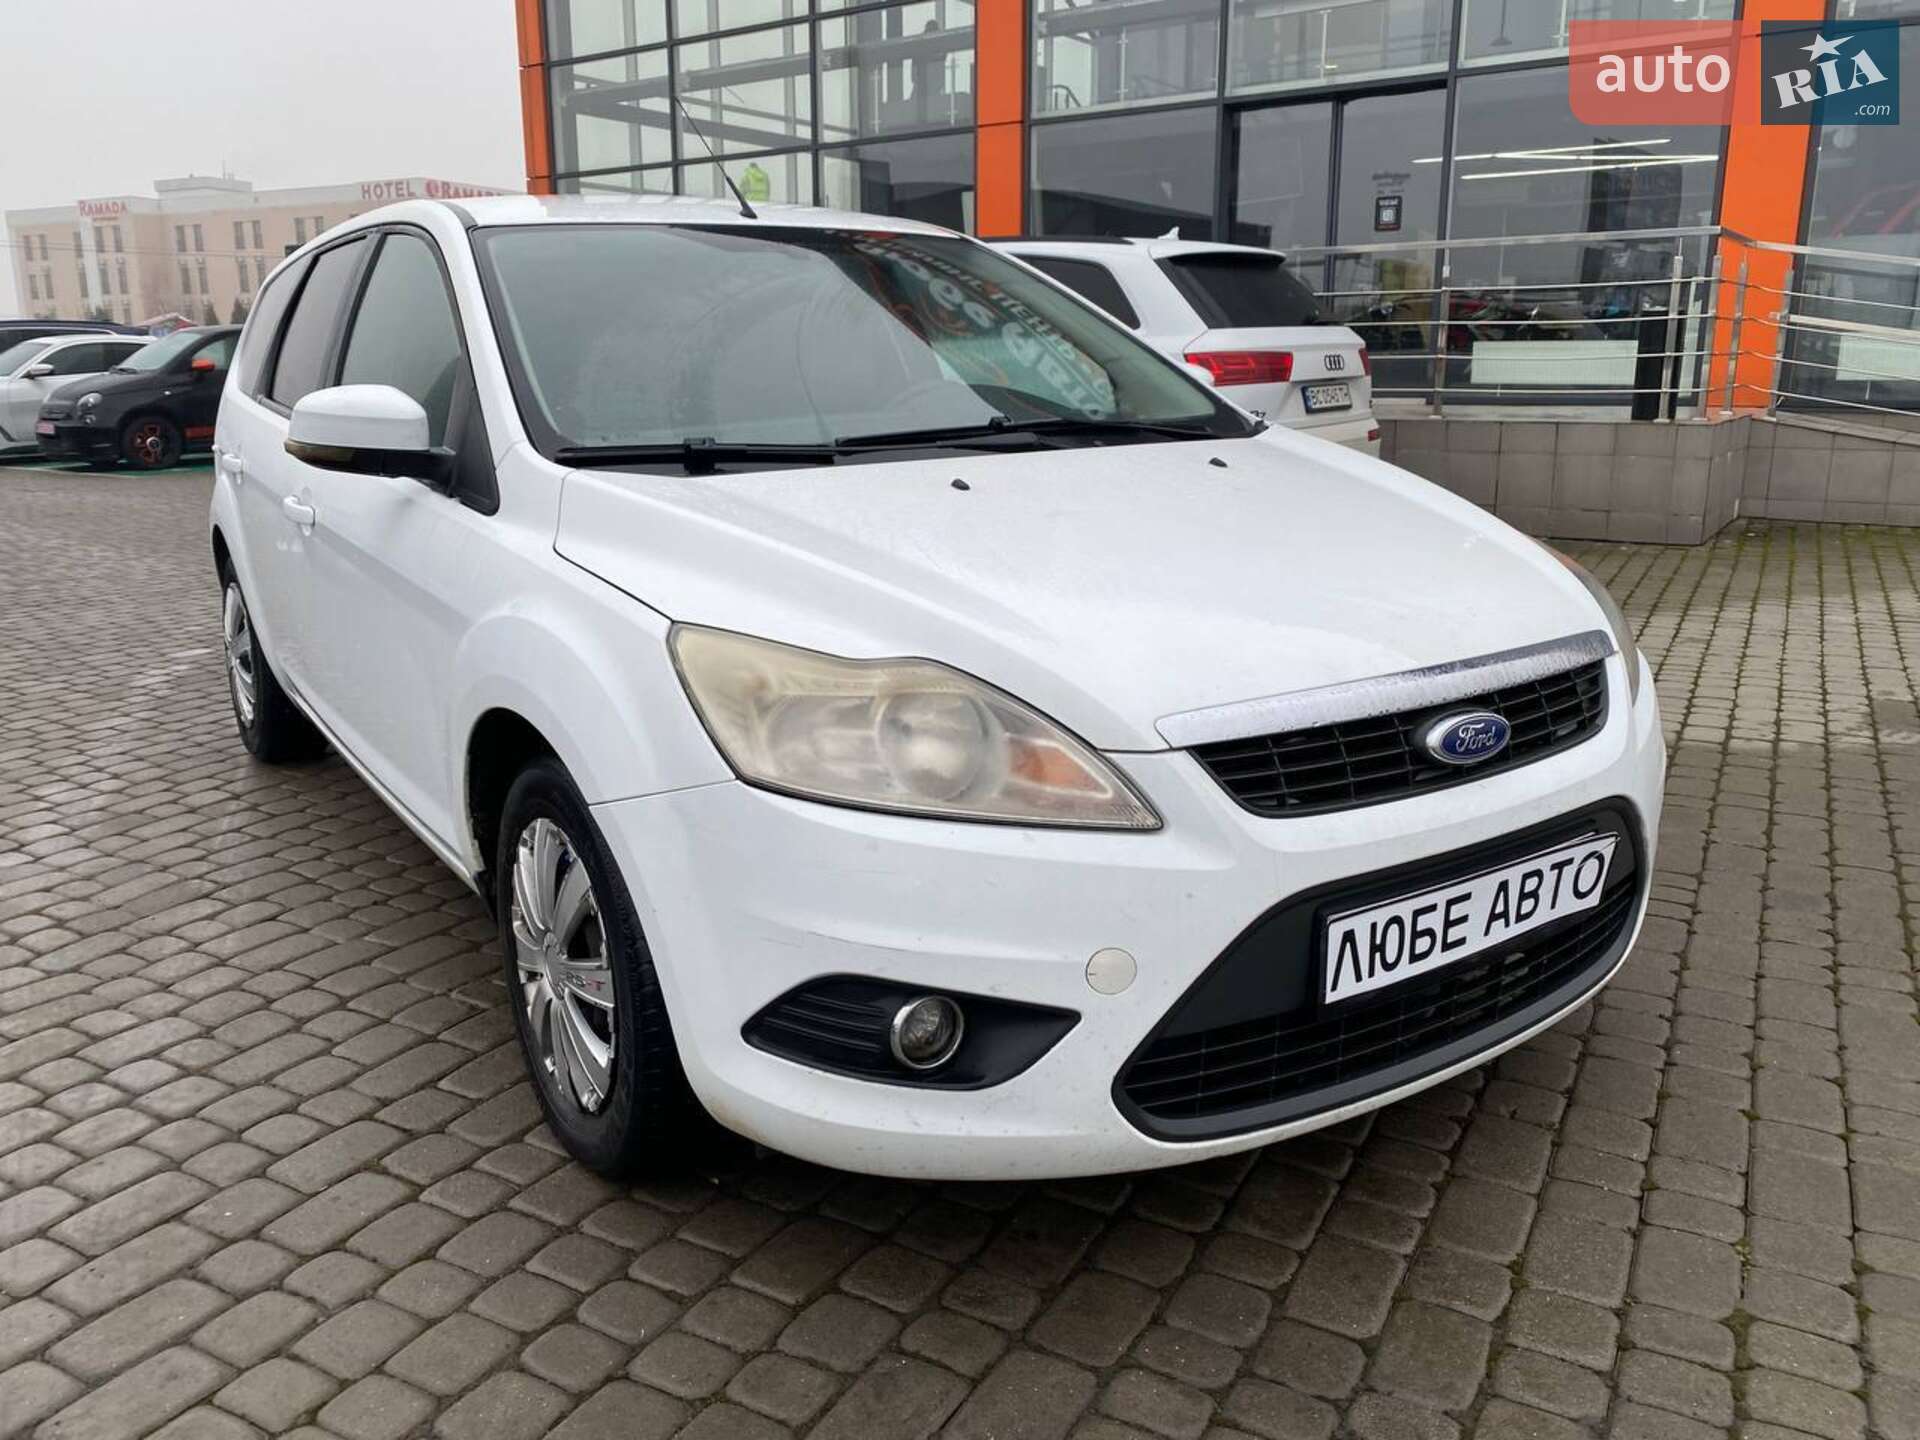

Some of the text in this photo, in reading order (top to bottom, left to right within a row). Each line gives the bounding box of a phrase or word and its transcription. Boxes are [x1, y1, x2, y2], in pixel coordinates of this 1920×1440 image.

[361, 180, 417, 200] HOTEL
[78, 200, 128, 217] RAMADA
[1456, 723, 1497, 752] Ford
[1330, 850, 1606, 993] ЛЮБЕ АВТО
